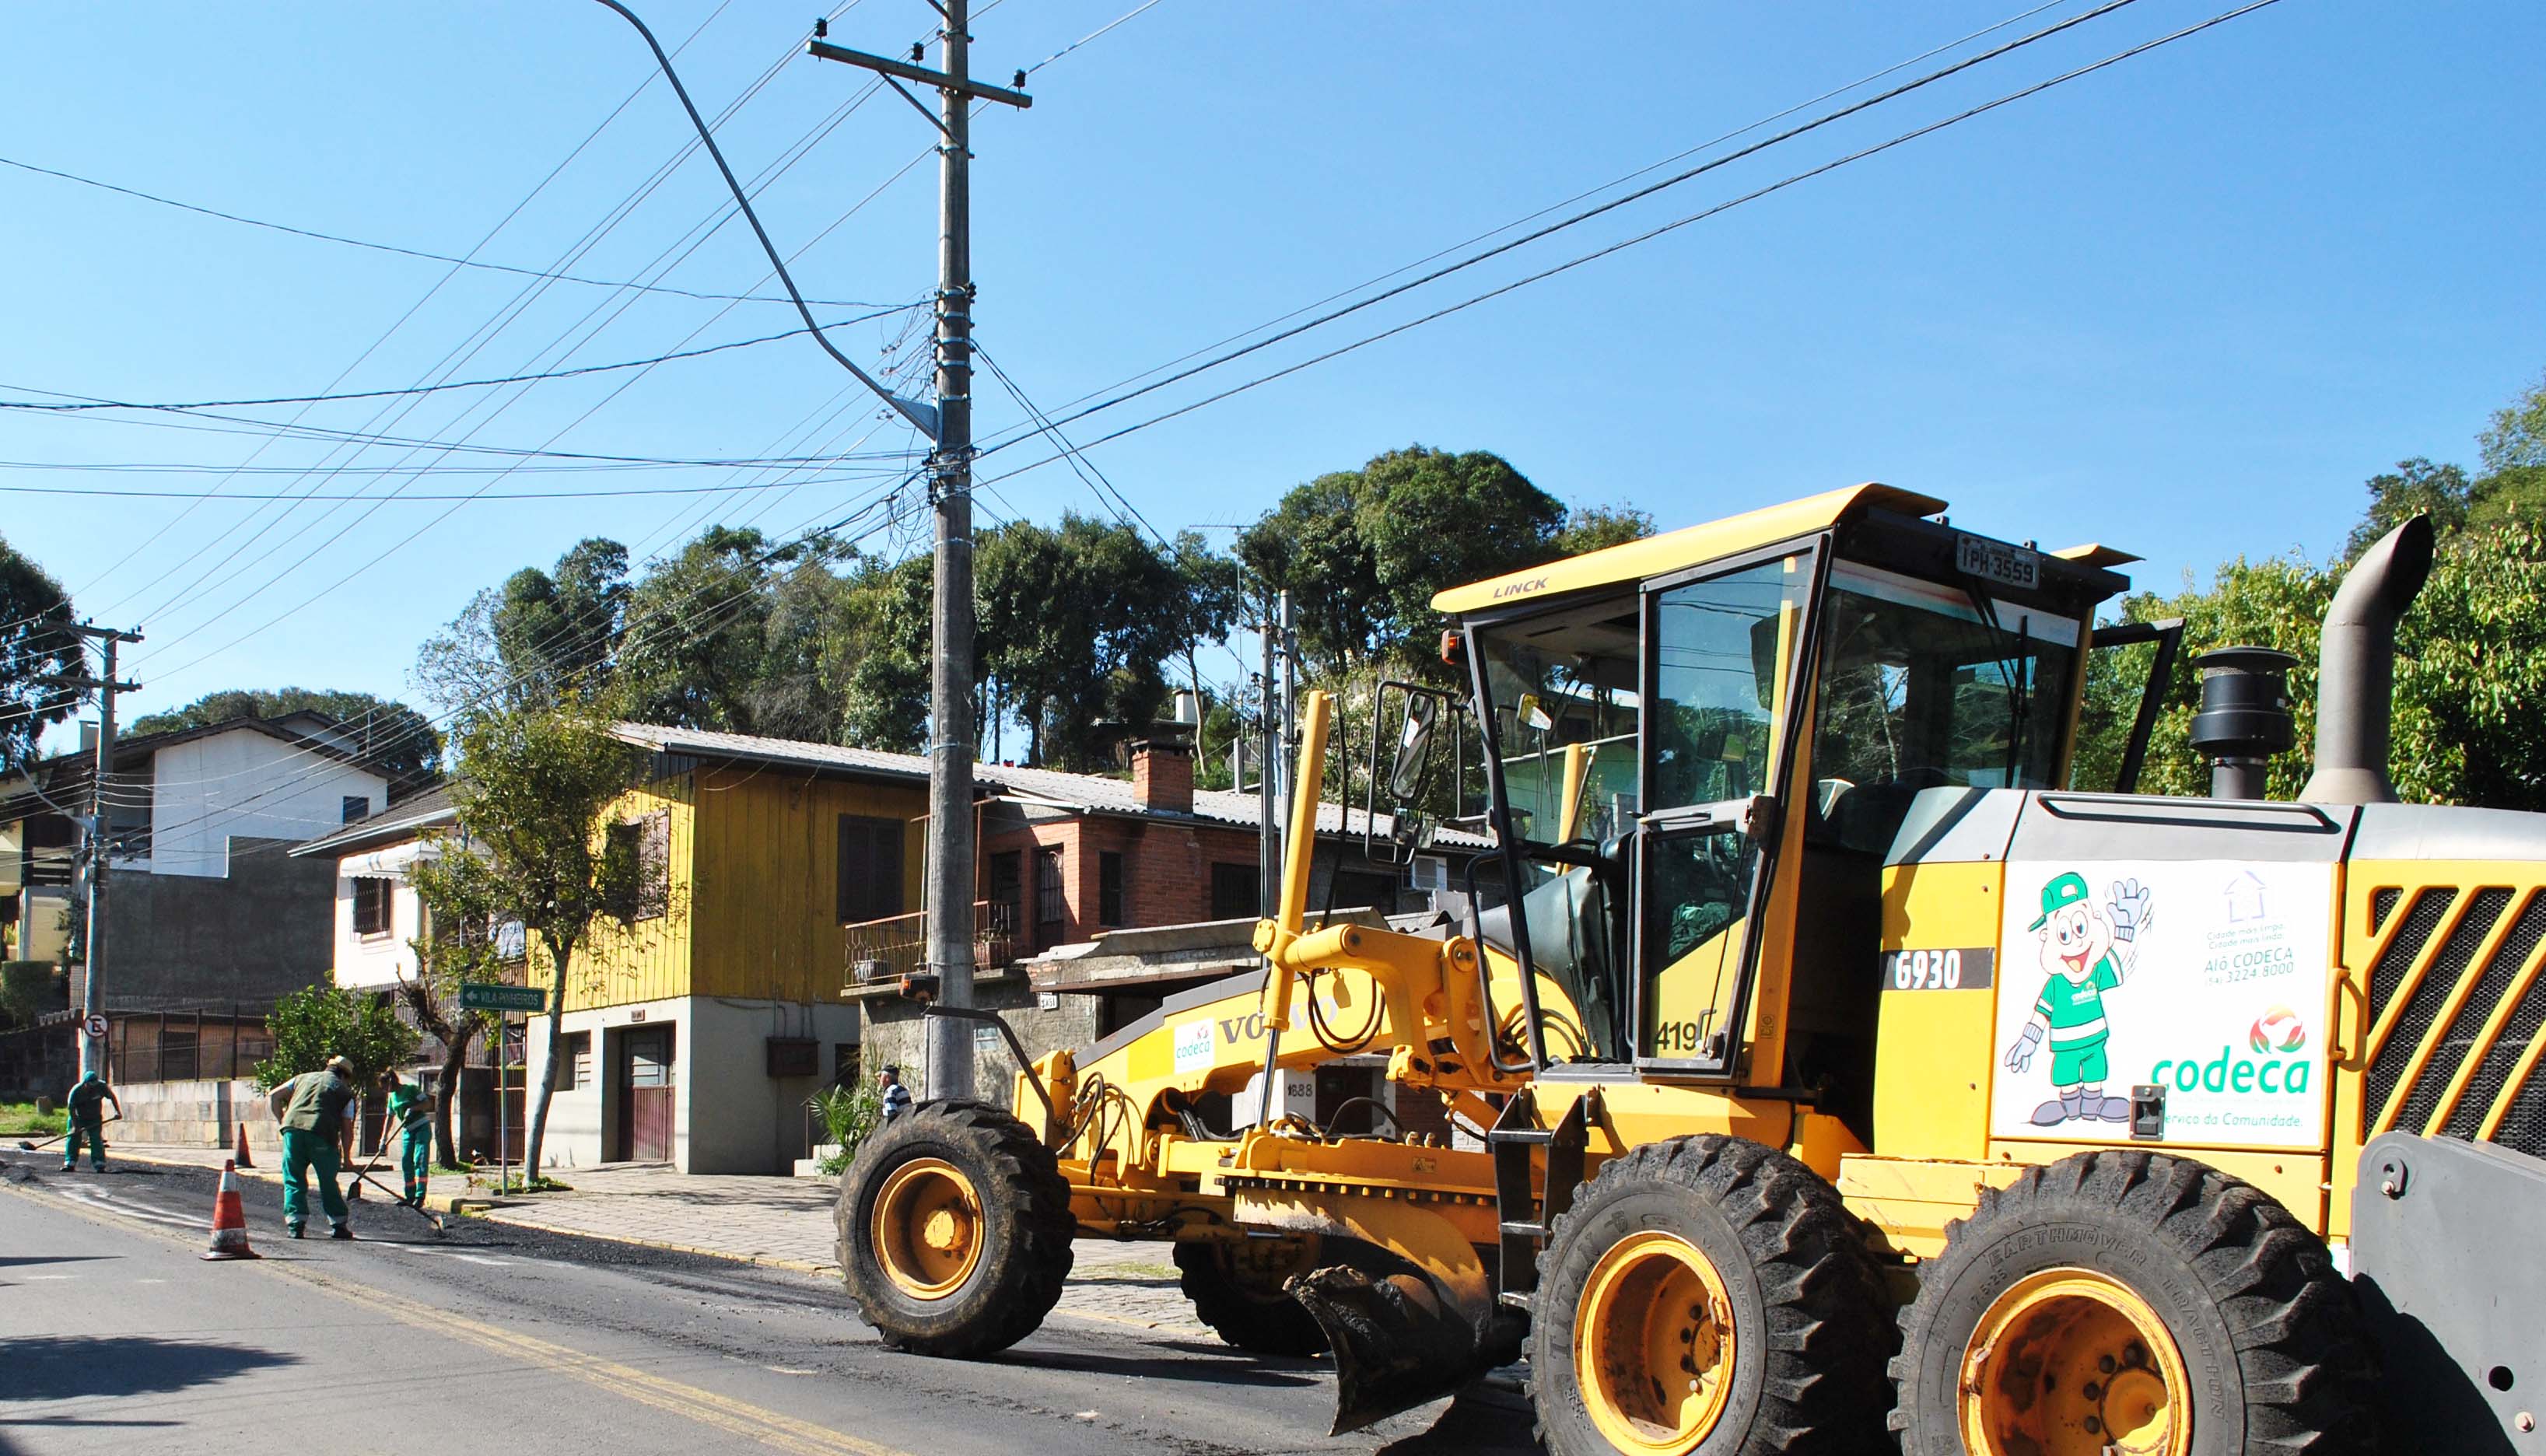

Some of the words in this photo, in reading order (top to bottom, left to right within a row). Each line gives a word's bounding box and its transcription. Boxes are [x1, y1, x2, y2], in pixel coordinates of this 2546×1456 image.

[2233, 947, 2292, 968] CODECA
[480, 990, 498, 1004] VILA
[1219, 996, 1338, 1044] VOVO
[1655, 1021, 1697, 1050] 419
[1175, 1038, 1210, 1059] codeca
[2151, 1045, 2311, 1094] codeca
[1287, 1083, 1312, 1097] 1688
[2204, 1112, 2218, 1125] da
[1987, 1227, 2147, 1268] EARTHMOVER
[1494, 1355, 1549, 1376] LINCK
